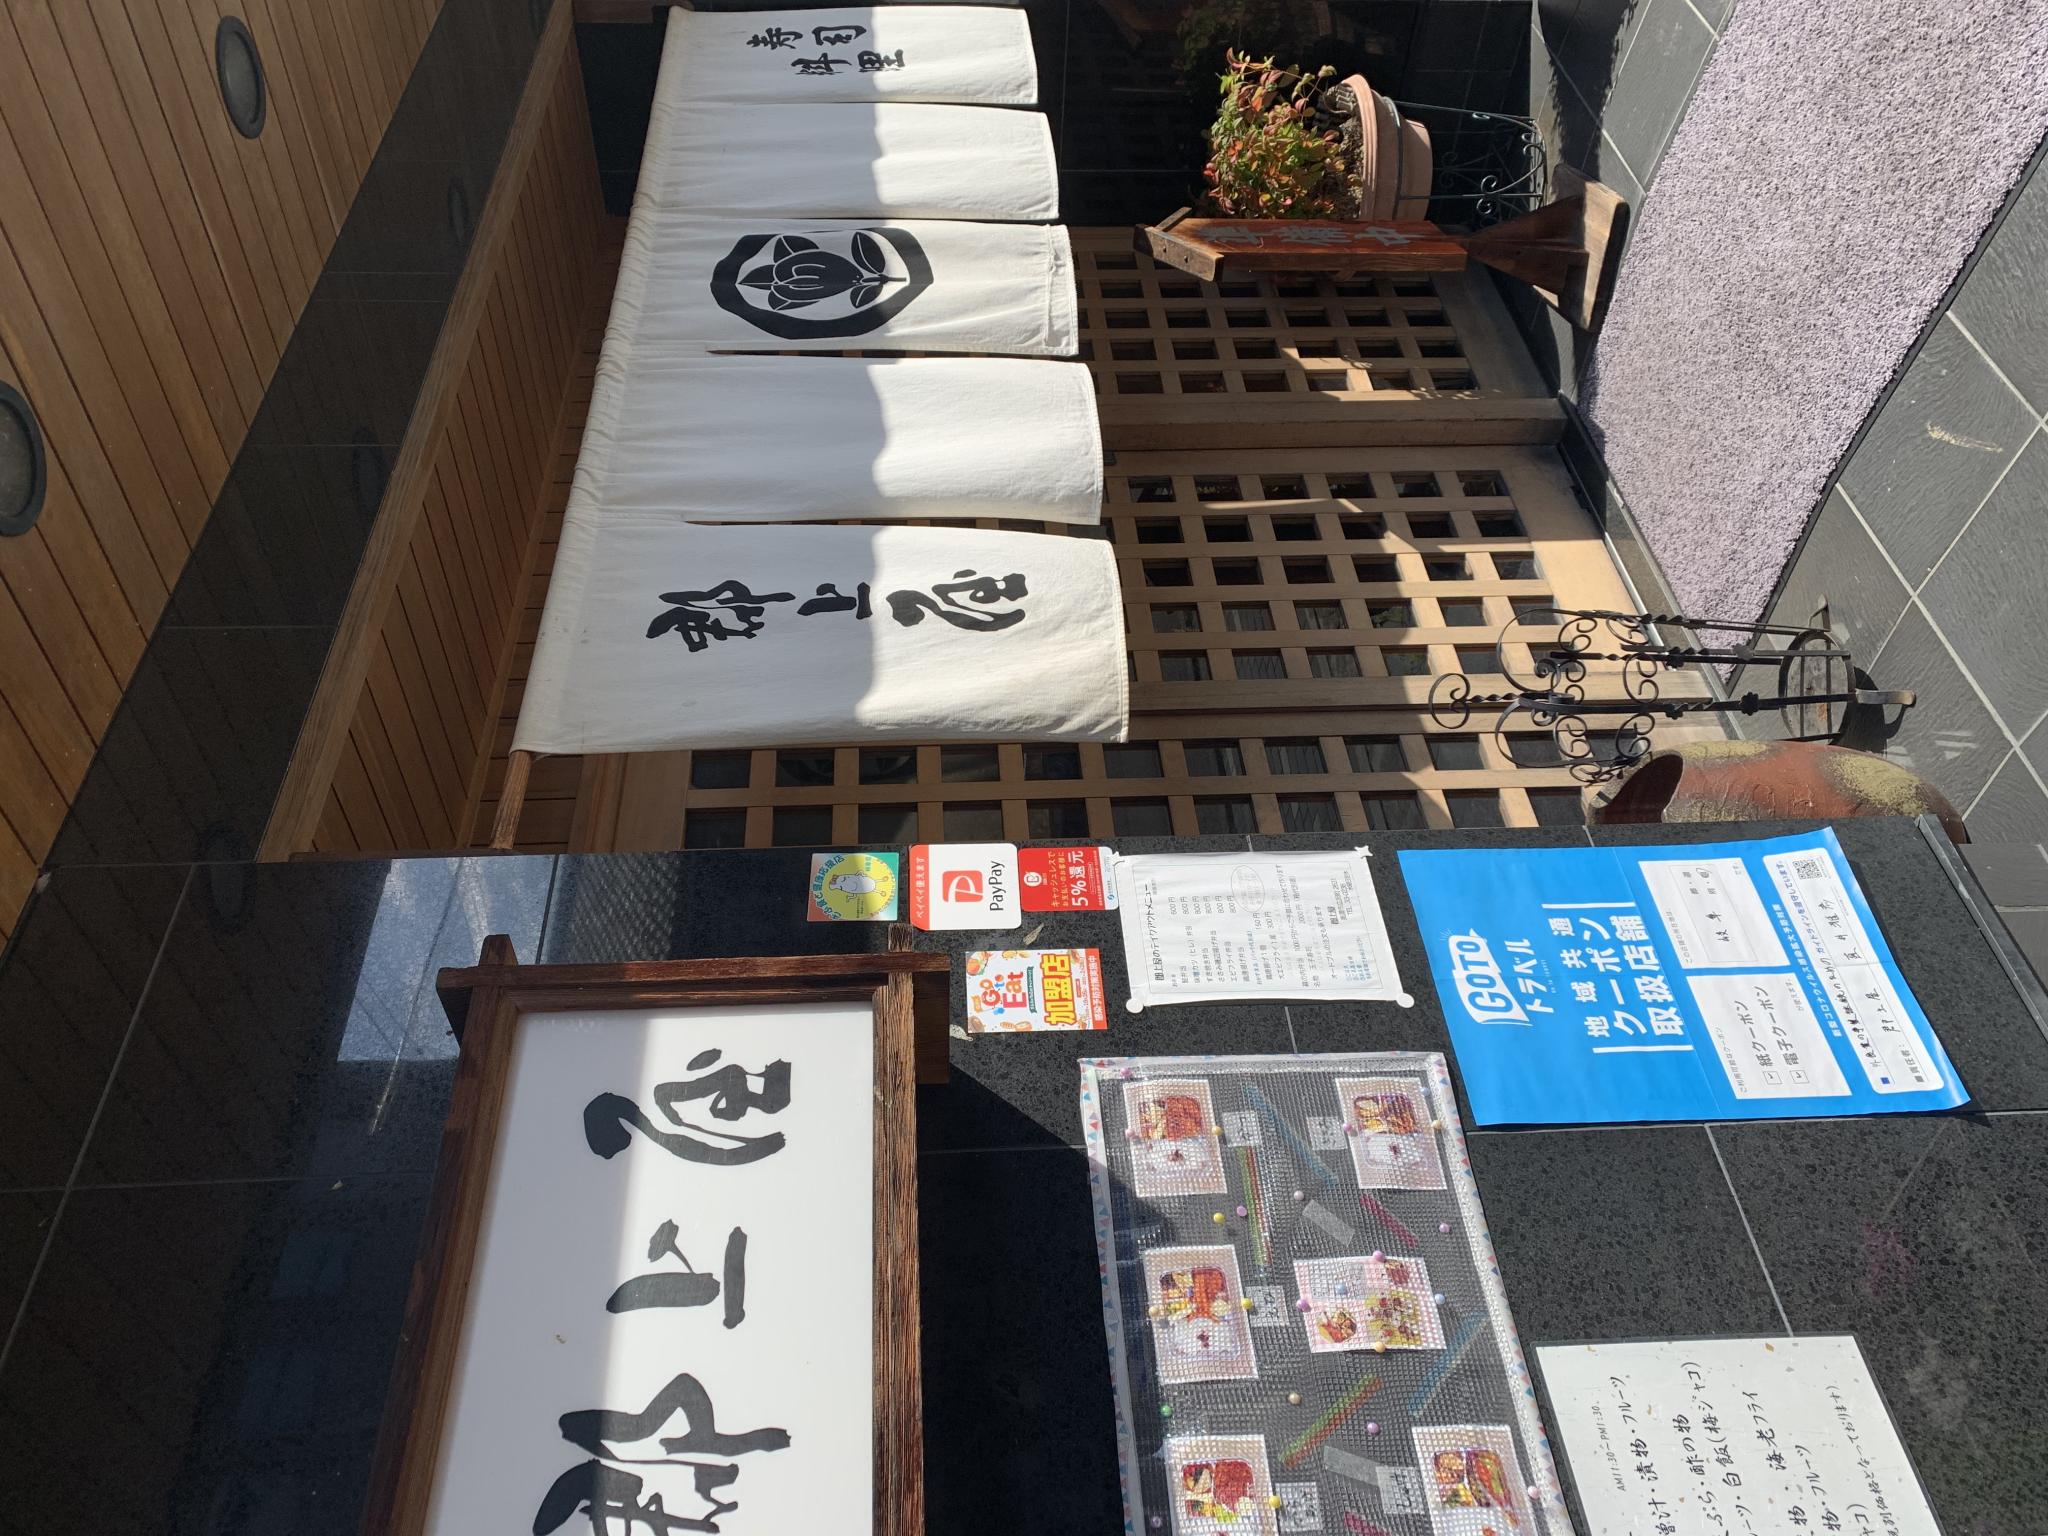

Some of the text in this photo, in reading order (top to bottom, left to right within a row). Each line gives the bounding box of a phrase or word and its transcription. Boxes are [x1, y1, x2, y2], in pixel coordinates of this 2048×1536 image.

[745, 24, 868, 50] 寿司
[791, 49, 905, 76] 料理
[645, 569, 1028, 653] 郡上屋
[915, 856, 926, 918] ペイペイ使えます
[988, 860, 1006, 911] PayPay
[1048, 851, 1060, 907] キャッシュレスで
[1058, 852, 1069, 907] お支払いのお客様に
[1067, 850, 1089, 907] 5%還元
[979, 978, 1001, 1007] Go
[1003, 970, 1028, 1009] Eat
[1042, 954, 1077, 1025] 加盟店
[1504, 938, 1554, 1014] トラベル
[1548, 917, 1610, 1038] 地域共通
[1578, 917, 1647, 1035] クーポン
[1609, 915, 1685, 1036] 取扱店舗
[1733, 1000, 1774, 1068] 紙クーポン
[1754, 986, 1799, 1066] 電子クーポン
[532, 1048, 791, 1536] 郡上屋
[1672, 1414, 1729, 1536] ぷら・酢の物
[1742, 1391, 1815, 1536] 物・海老フライ
